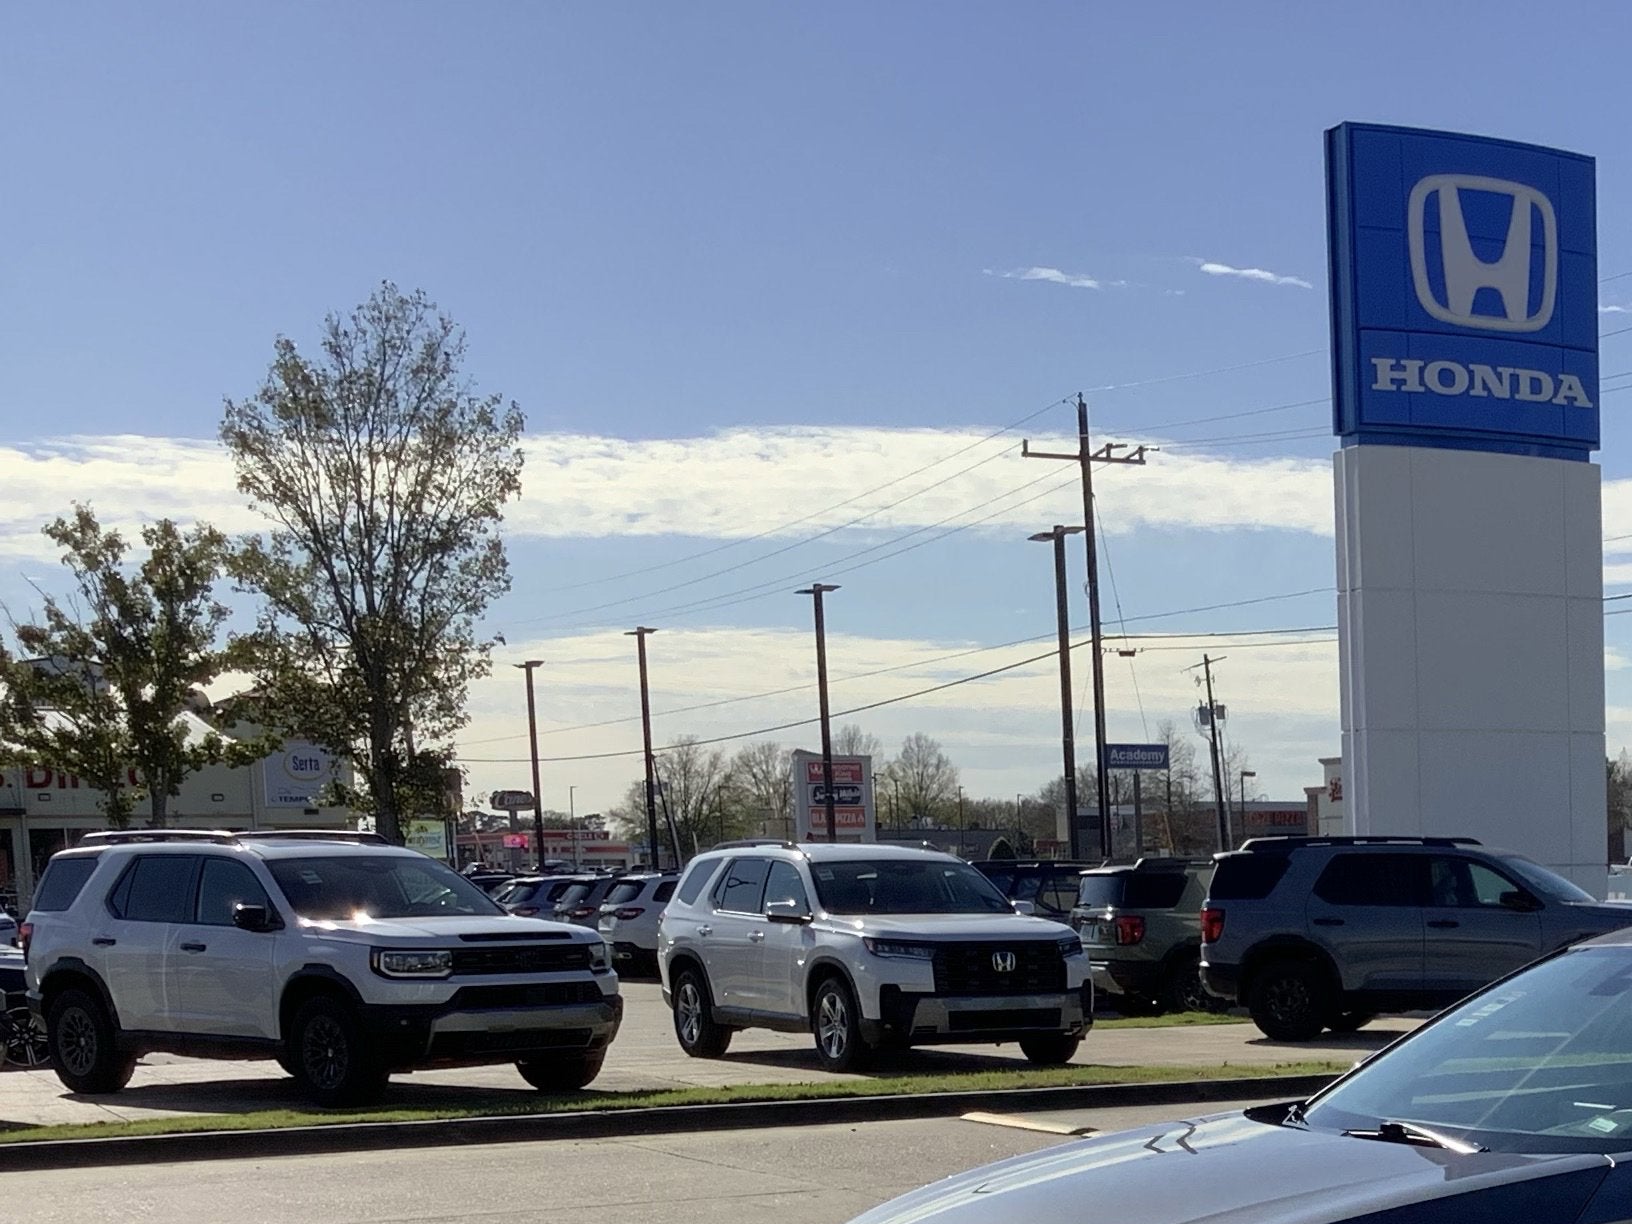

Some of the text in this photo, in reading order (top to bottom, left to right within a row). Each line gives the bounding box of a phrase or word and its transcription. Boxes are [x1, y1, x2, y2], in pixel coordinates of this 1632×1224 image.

[1370, 357, 1593, 408] HONDA
[292, 755, 320, 771] Serta
[1110, 749, 1165, 763] Academy
